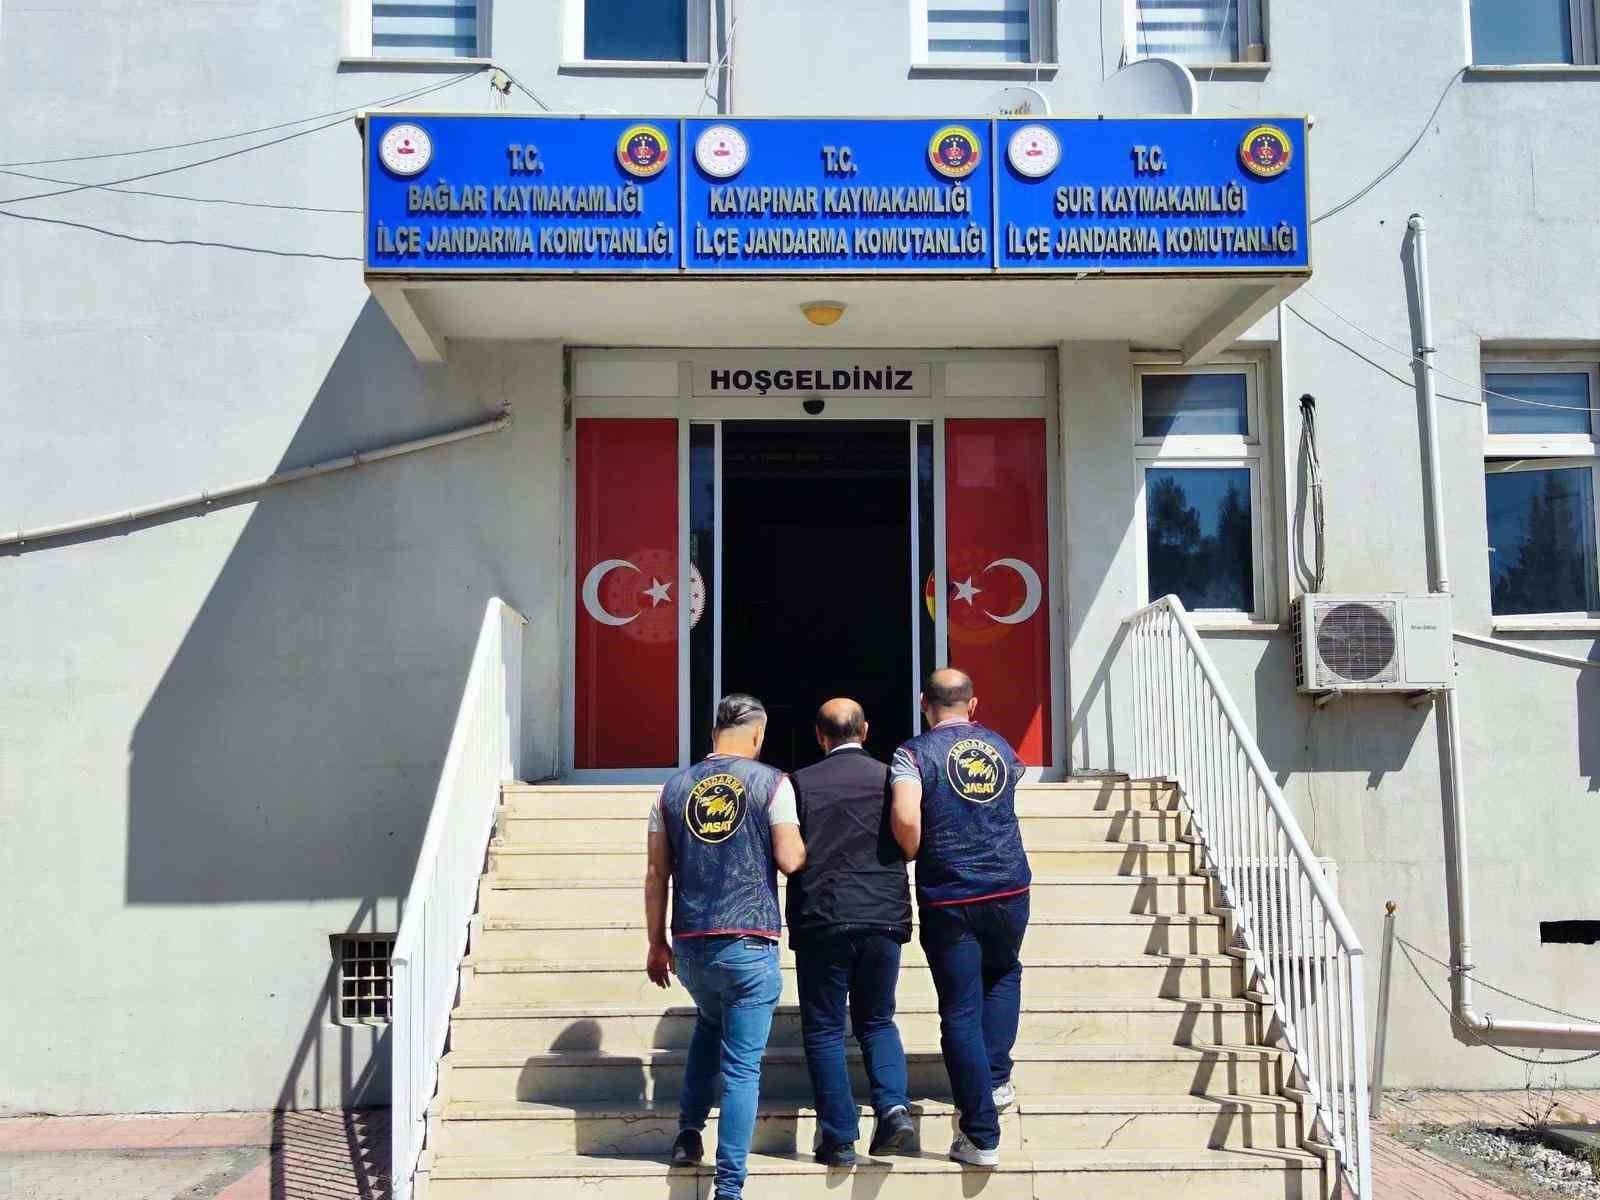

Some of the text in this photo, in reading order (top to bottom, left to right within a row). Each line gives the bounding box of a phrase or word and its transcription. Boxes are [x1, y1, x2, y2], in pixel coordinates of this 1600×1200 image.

[509, 144, 544, 171] T.C.
[823, 146, 858, 172] T.C.
[1134, 145, 1167, 171] T.C.
[408, 177, 643, 212] BAĞLAR KAYMAKAMLIĞI
[710, 181, 971, 213] KAYAPINAR KAYMAKAMLIĞI
[1056, 180, 1248, 212] SUR KAYMAKAMLIĞI
[377, 221, 674, 256] İLÇE JANDARMA KOMUTANLIĞI
[696, 222, 986, 257] İLÇE JANDARMA KOMUTANLIĞI
[1008, 220, 1297, 256] İLÇE JANDARMA KOMUTANLIĞI
[710, 365, 913, 395] HOŞGELDİNİZ
[963, 782, 994, 794] JASAT
[699, 821, 733, 834] JASAT
